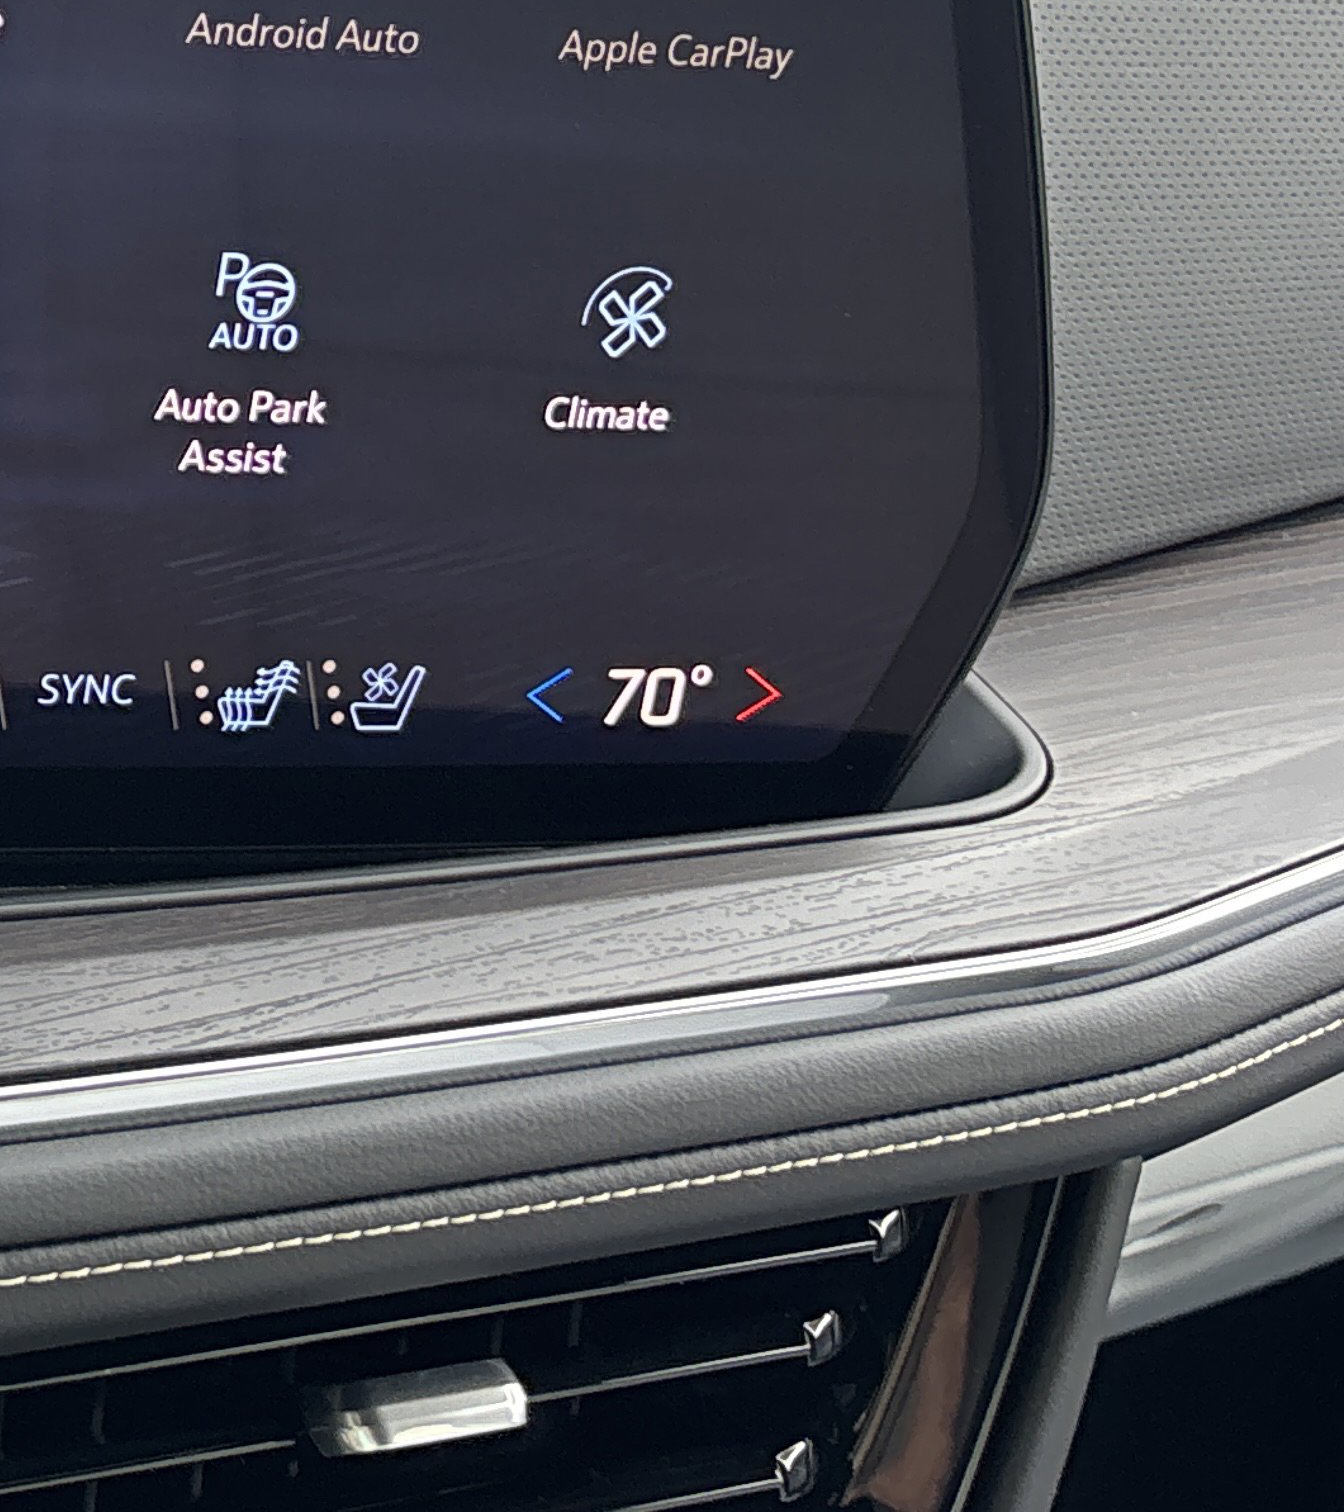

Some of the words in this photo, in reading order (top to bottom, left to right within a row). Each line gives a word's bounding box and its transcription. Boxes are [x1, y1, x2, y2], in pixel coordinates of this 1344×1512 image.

[184, 11, 330, 51] Android
[334, 18, 421, 55] Auto
[557, 28, 658, 73] Apple
[667, 32, 795, 81] CarPlay
[208, 321, 299, 352] AUTO
[152, 387, 242, 424] Auto
[247, 388, 328, 425] Park
[543, 394, 671, 432] Climate
[176, 438, 288, 475] Assist
[36, 672, 138, 706] SYNC
[602, 663, 715, 728] 70°
